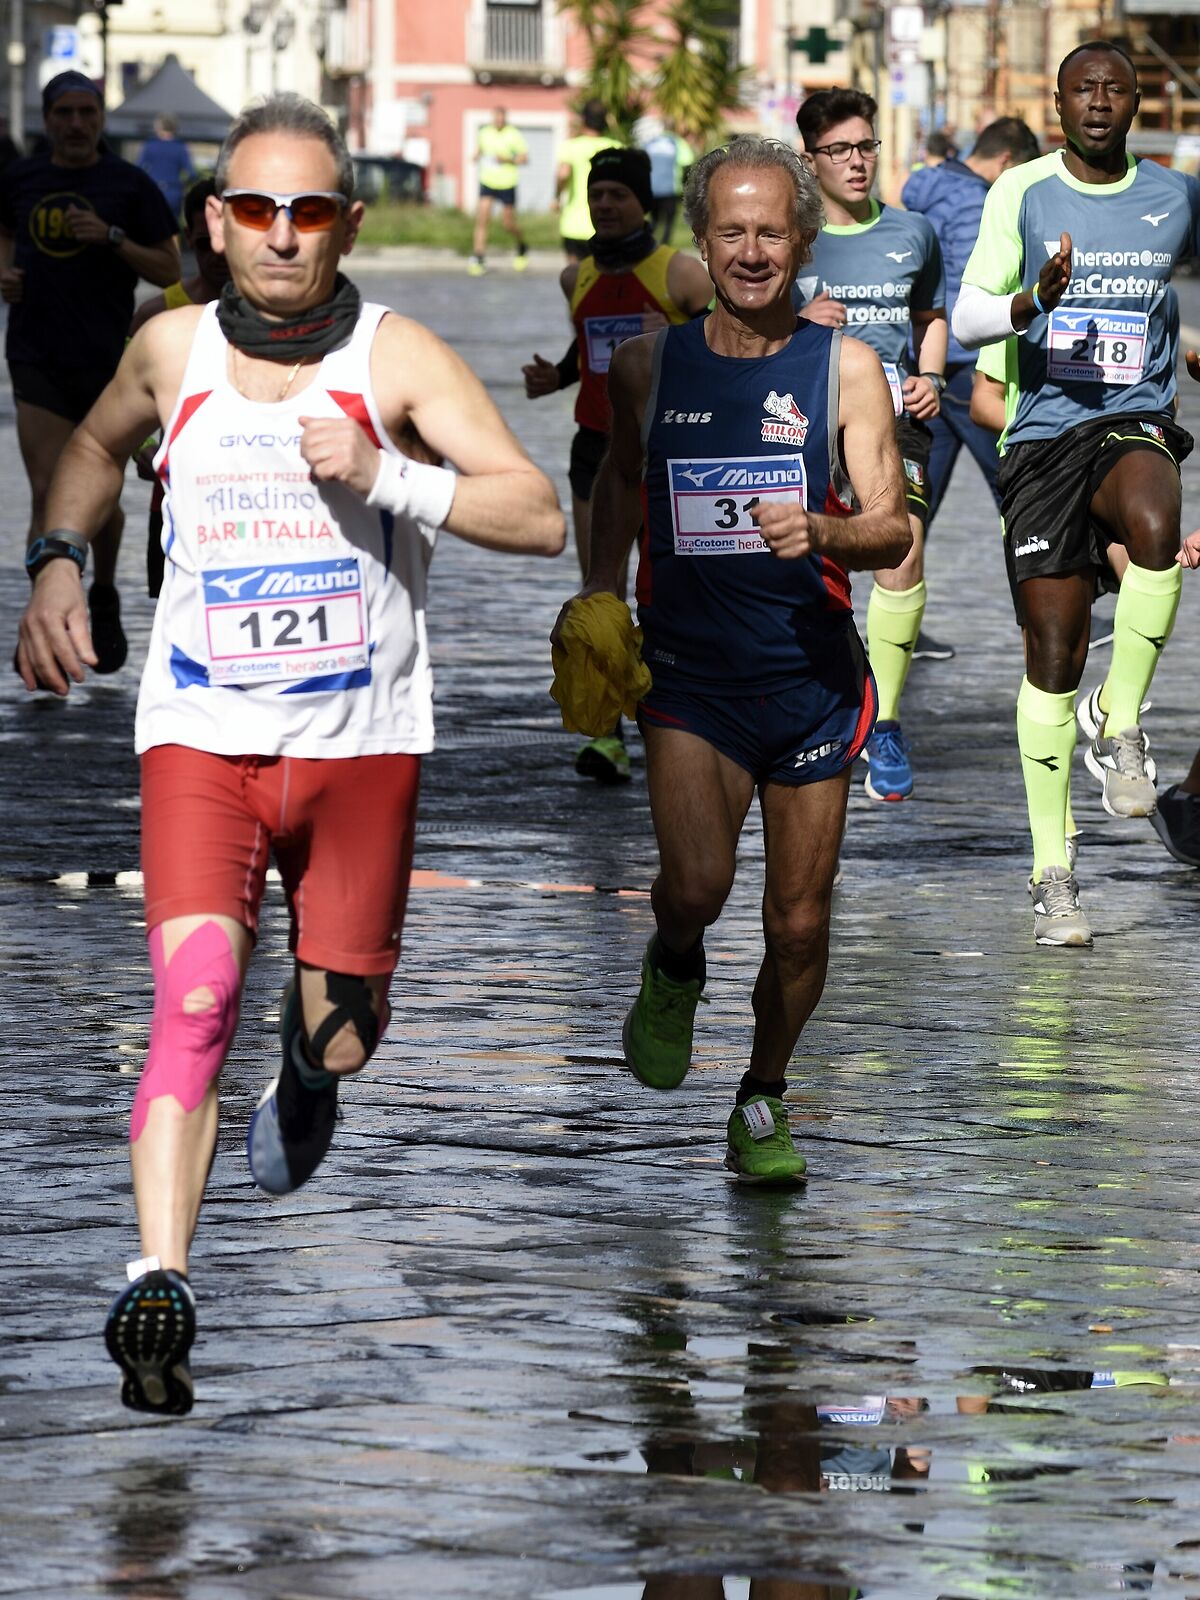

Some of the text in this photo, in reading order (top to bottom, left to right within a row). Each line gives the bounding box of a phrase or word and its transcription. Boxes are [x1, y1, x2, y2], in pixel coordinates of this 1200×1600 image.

[37, 207, 75, 238] 19
[1073, 247, 1172, 267] heraora com
[822, 281, 881, 298] heraora
[846, 304, 910, 323] rotone
[1070, 338, 1128, 364] 218
[762, 424, 806, 438] MILON
[763, 434, 804, 445] RUNNERS
[205, 486, 316, 516] Aladino
[197, 520, 334, 545] BAR ITALIA
[677, 538, 736, 549] StraCrotone
[239, 605, 329, 649] 121
[285, 656, 338, 674] heraora
